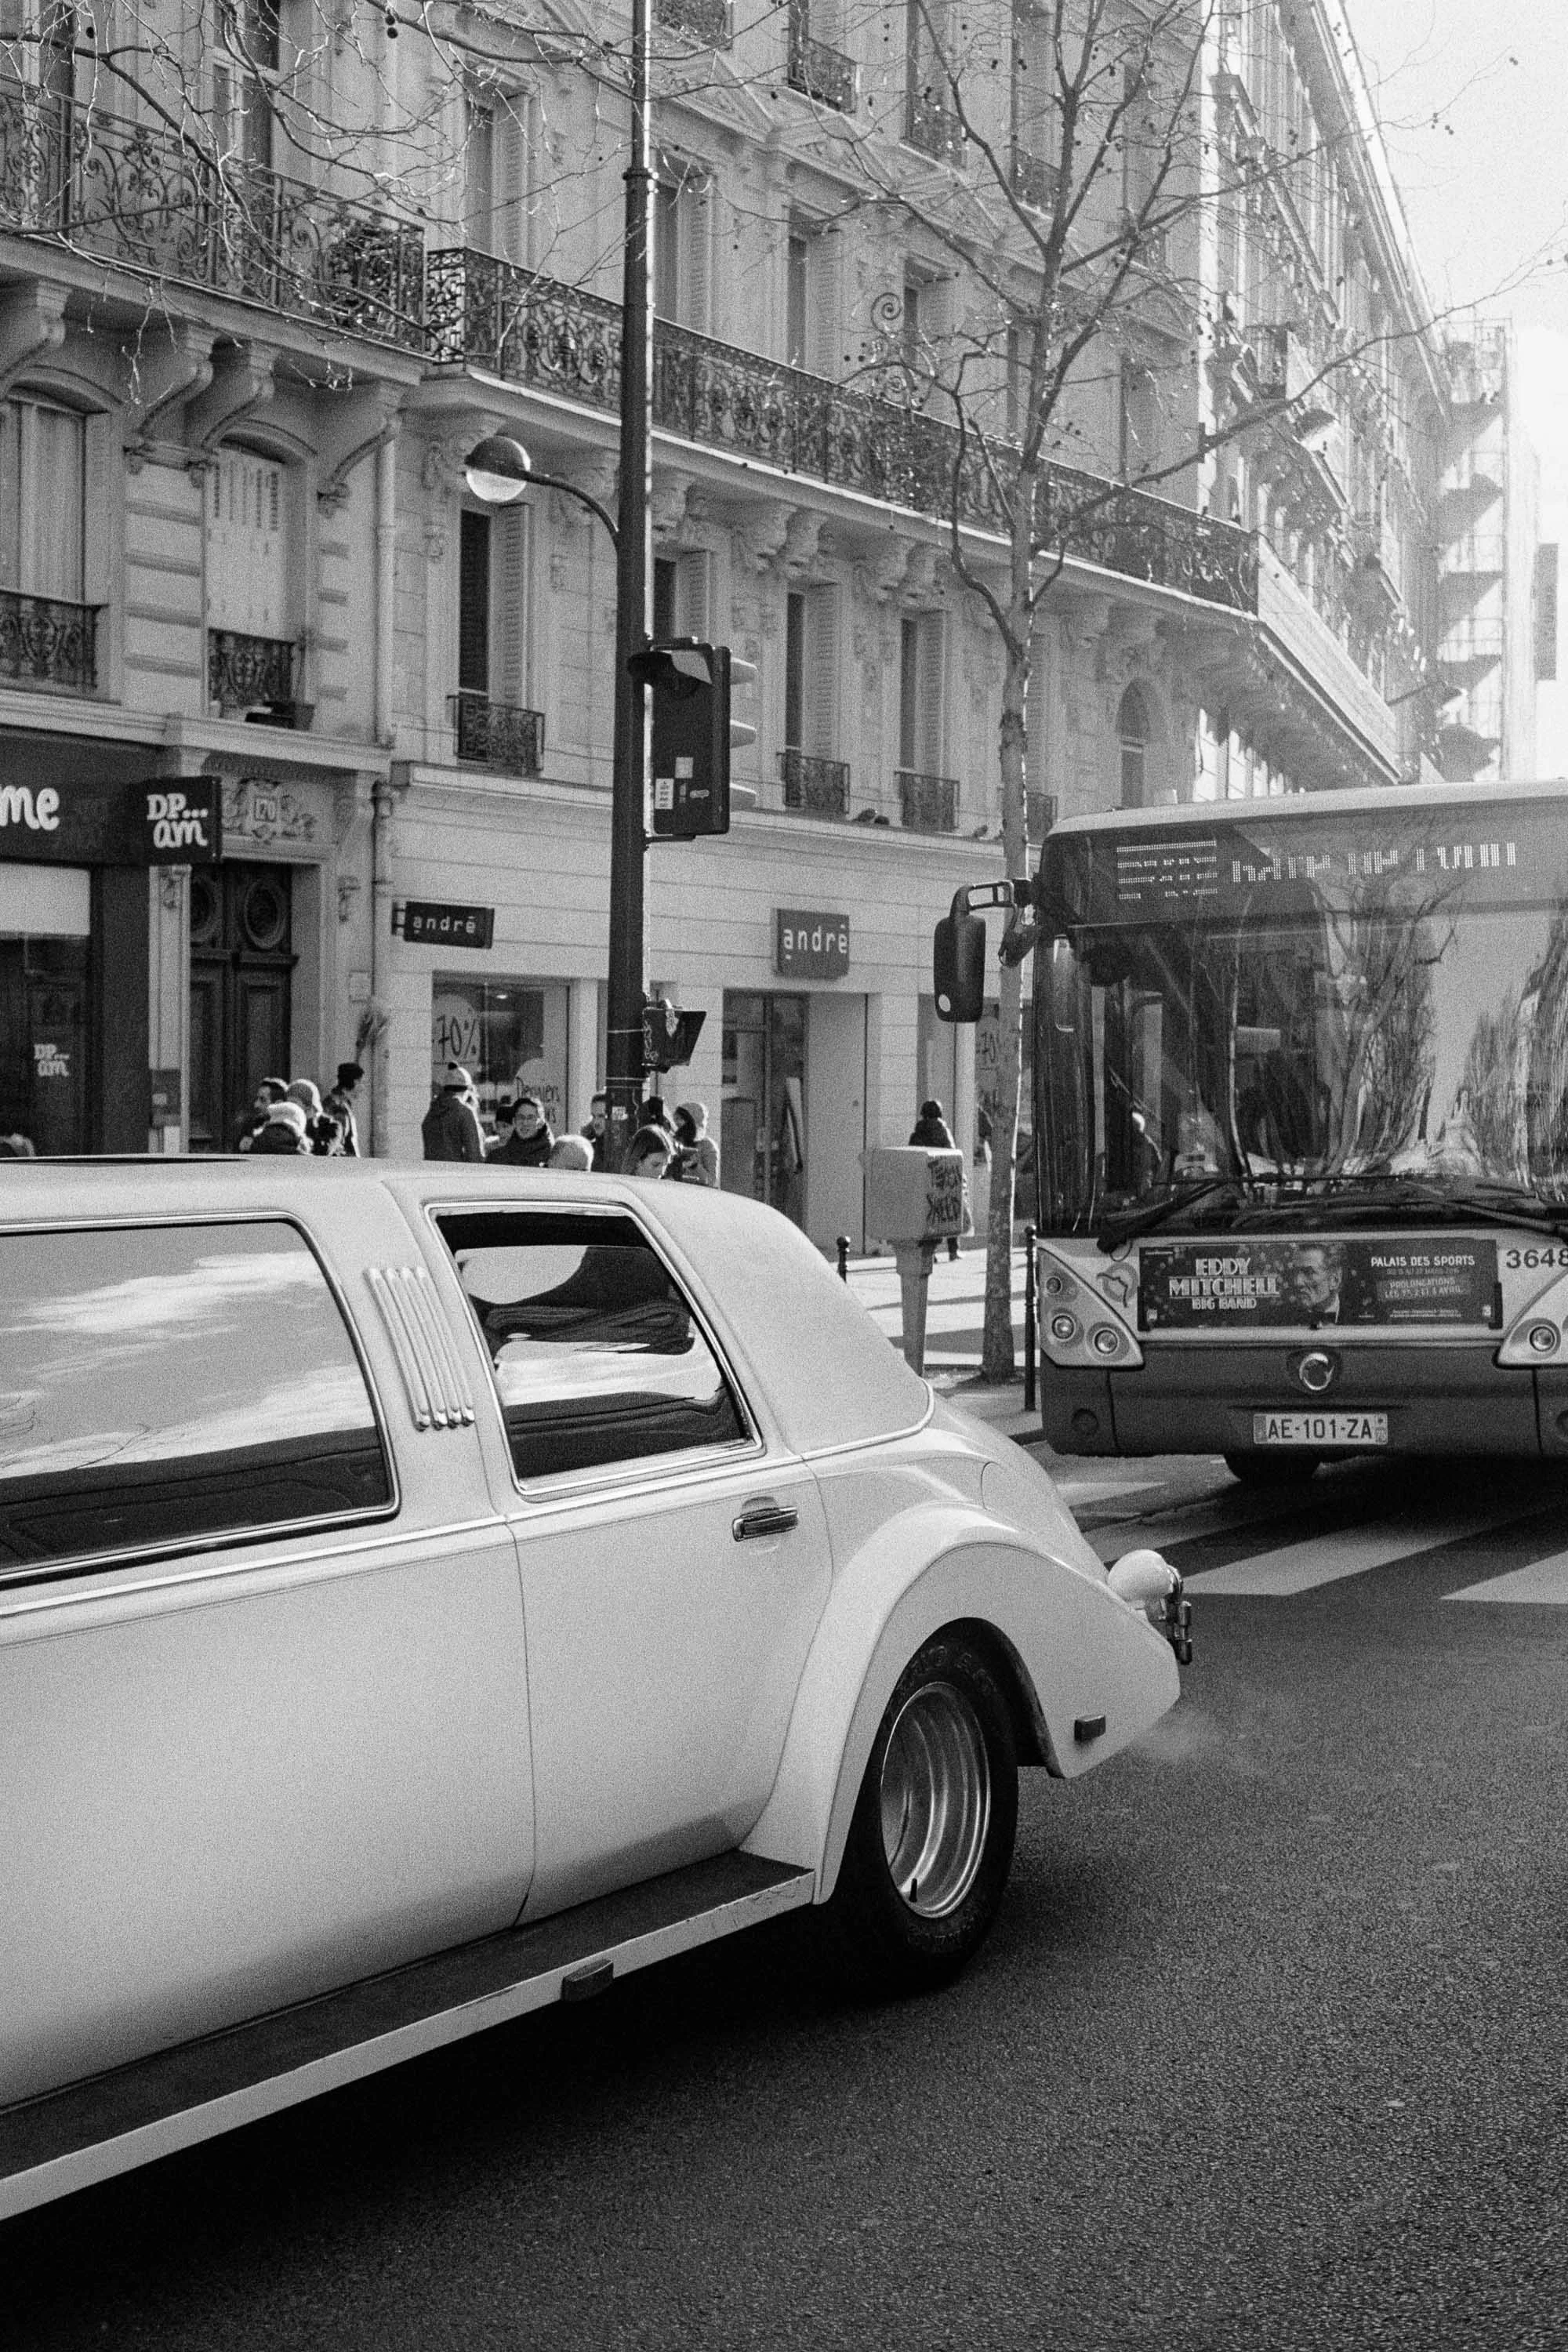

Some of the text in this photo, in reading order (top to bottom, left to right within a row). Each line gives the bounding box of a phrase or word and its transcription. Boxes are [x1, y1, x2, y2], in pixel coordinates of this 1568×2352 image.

[153, 819, 209, 848] am
[37, 1059, 70, 1077] am
[1195, 1257, 1251, 1276] EDDY
[1370, 1255, 1475, 1267] PALAIS DES SPORTS
[1506, 1247, 1568, 1269] 3648
[1169, 1278, 1280, 1296] MITCHELL
[1192, 1297, 1258, 1310] BIG BAND
[1268, 1418, 1372, 1439] AE-101-ZA
